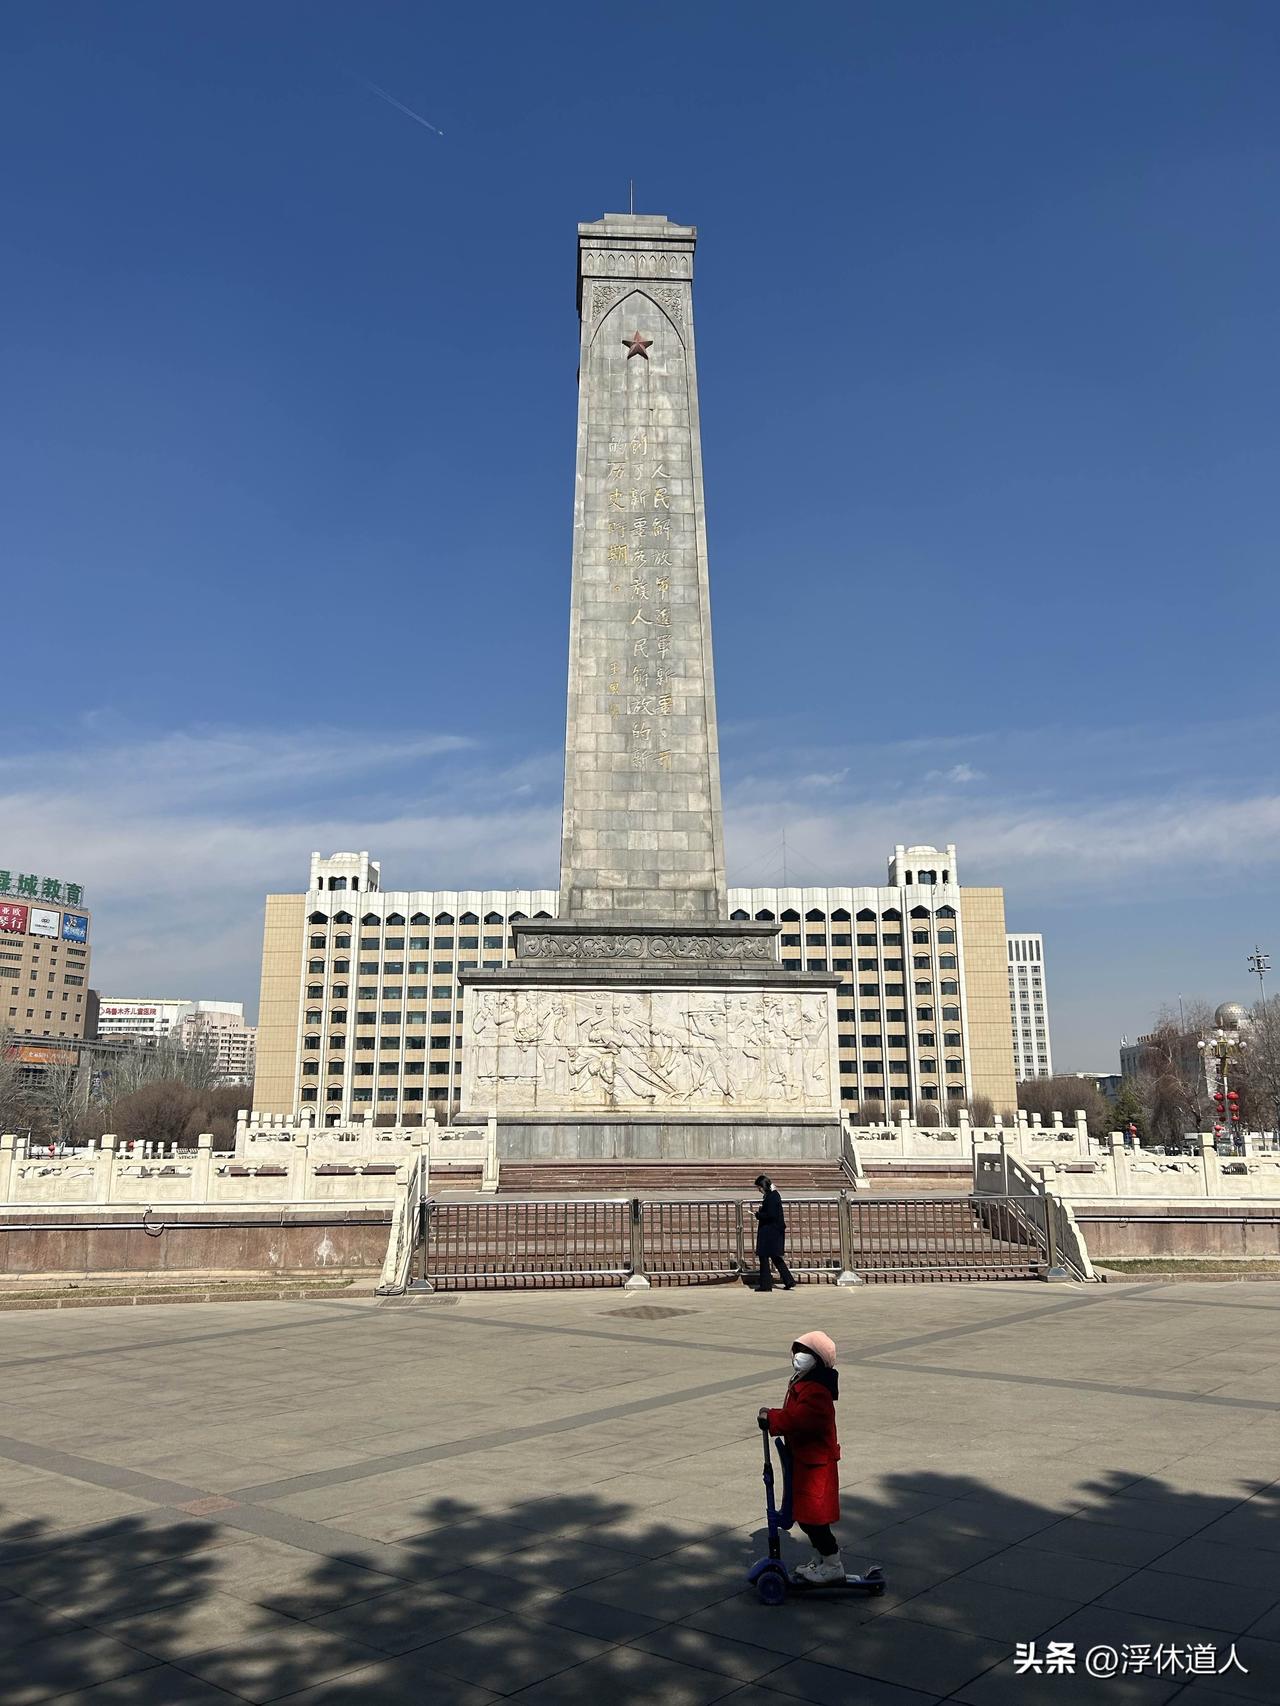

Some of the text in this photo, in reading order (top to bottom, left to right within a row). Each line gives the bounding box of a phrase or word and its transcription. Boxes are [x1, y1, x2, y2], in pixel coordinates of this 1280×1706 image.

[105, 1007, 157, 1016] 乌鲁木齐儿童医院
